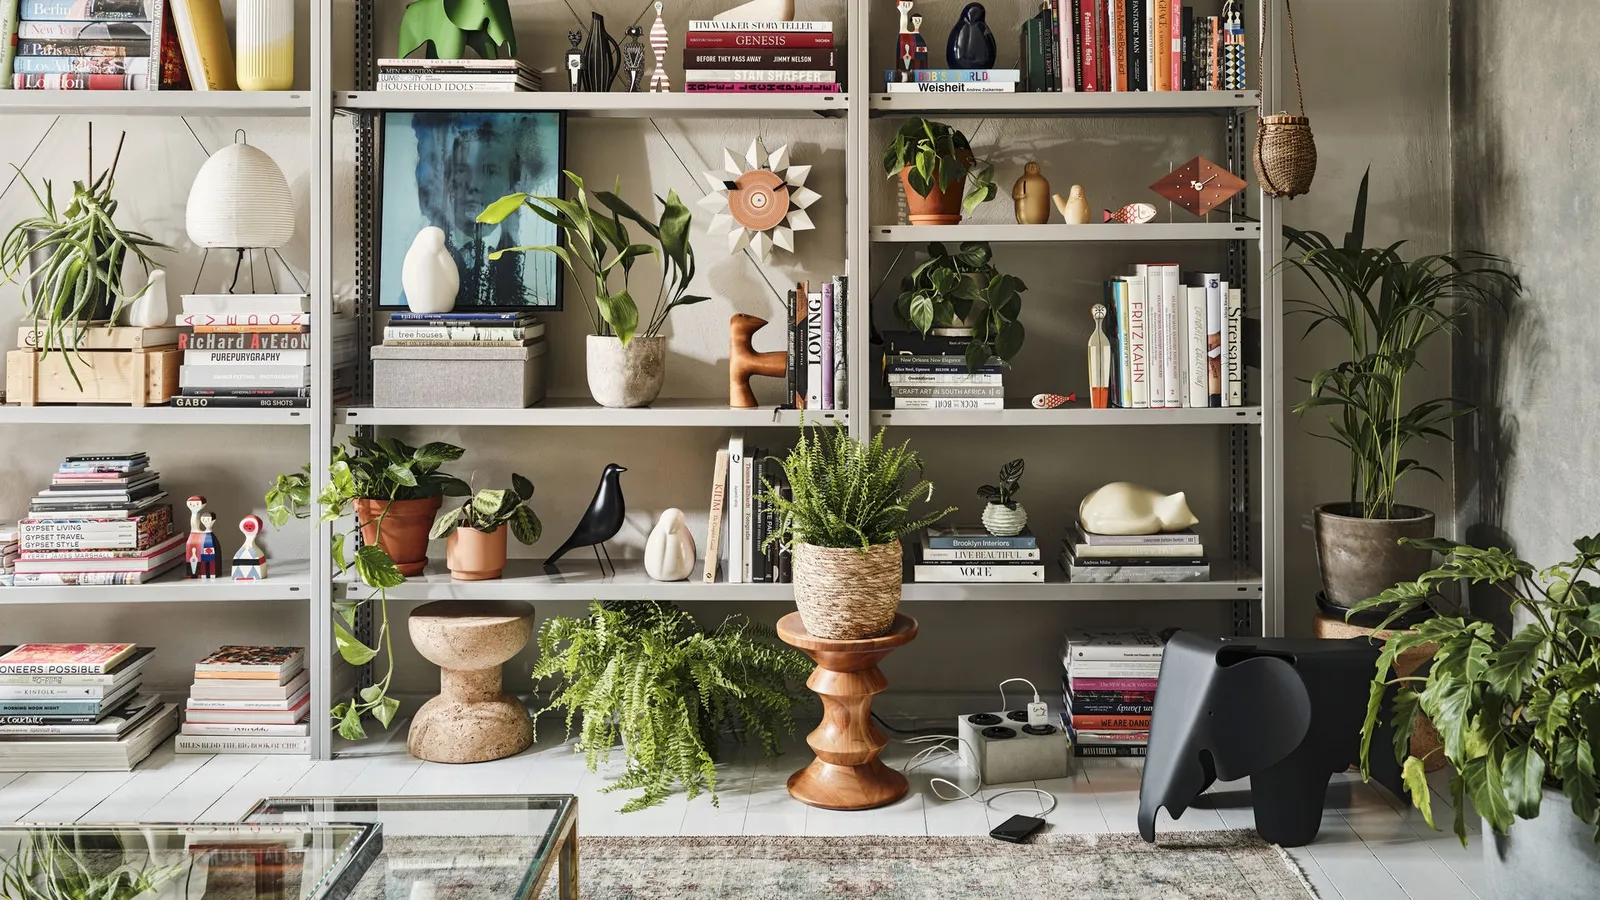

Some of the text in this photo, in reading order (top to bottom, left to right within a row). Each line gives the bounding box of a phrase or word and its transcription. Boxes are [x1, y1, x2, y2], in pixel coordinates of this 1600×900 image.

[34, 3, 72, 15] Berlin
[1159, 0, 1167, 28] GRACE
[31, 24, 54, 34] New
[736, 36, 786, 46] GENESIS
[32, 44, 62, 56] Paris
[27, 60, 44, 71] Los
[734, 71, 764, 81] STAN
[918, 71, 947, 80] BOB'S
[26, 75, 84, 88] Loon
[380, 83, 442, 91] HOUSEHOLD
[444, 83, 474, 91] IDOLS
[918, 83, 965, 92] Weisheit
[416, 329, 443, 338] houses
[809, 299, 821, 365] LOVING
[1132, 302, 1144, 383] FRITZ KAHN
[1228, 307, 1242, 382] Streisand
[713, 484, 723, 511] KILIM
[960, 567, 992, 576] VOGUE
[1117, 704, 1141, 713] Dandy
